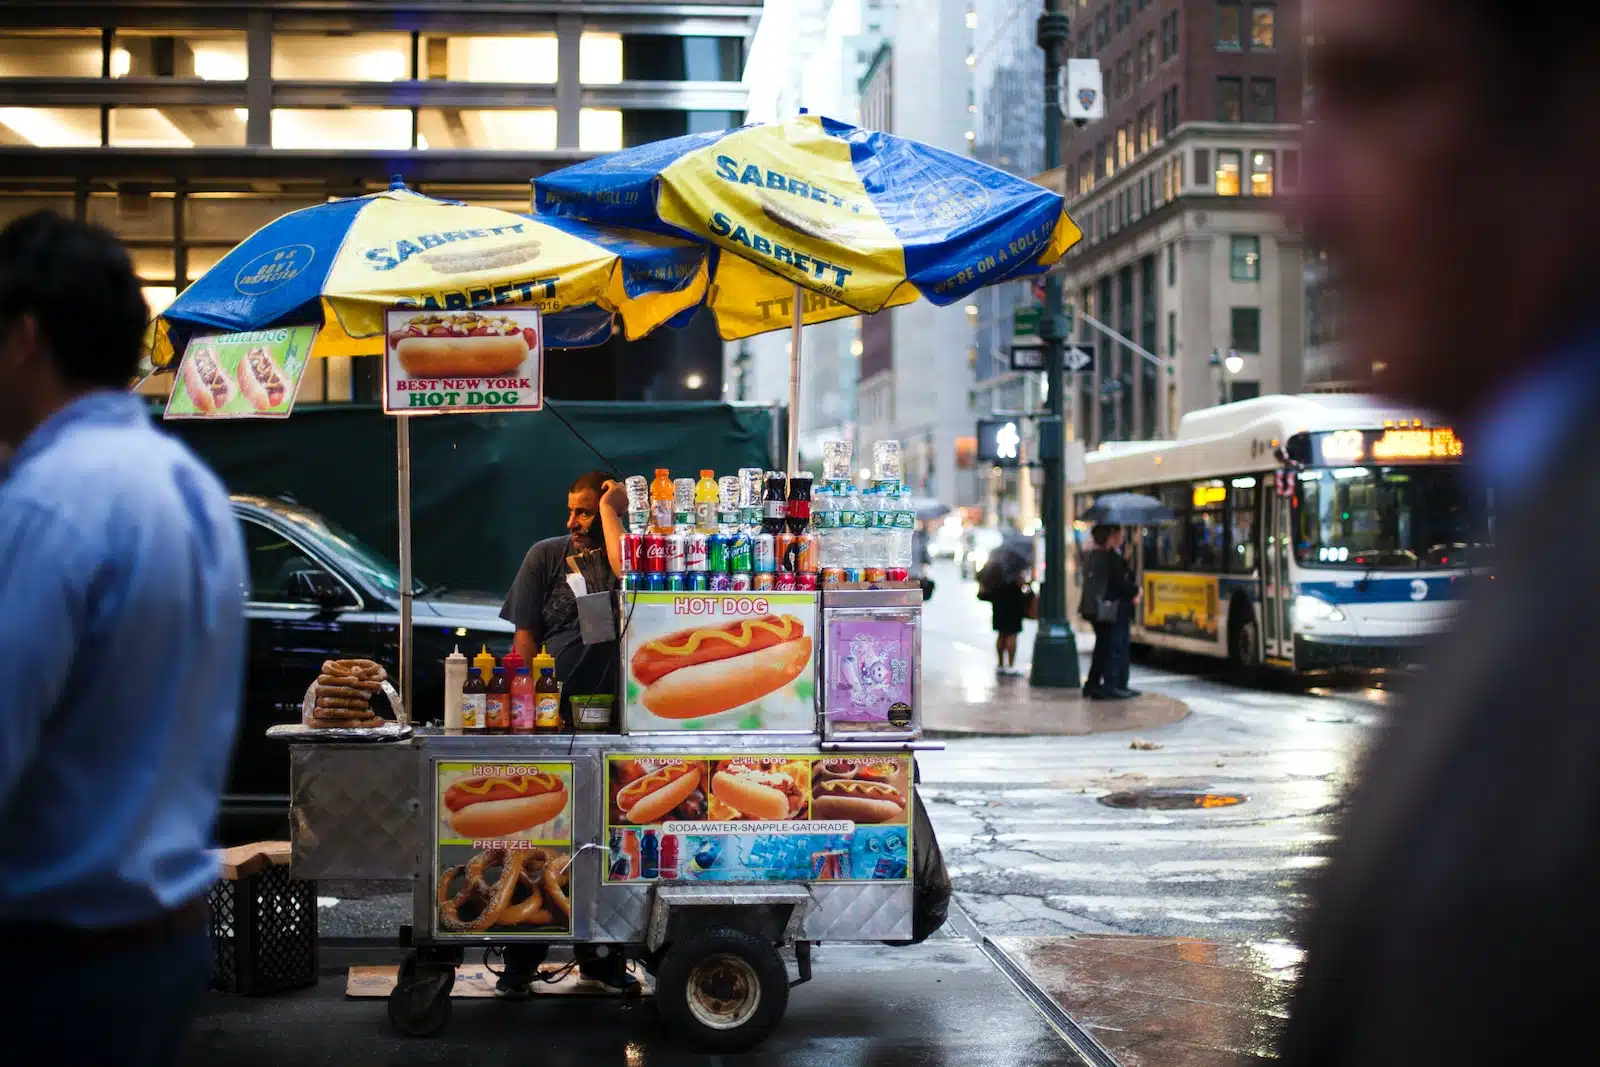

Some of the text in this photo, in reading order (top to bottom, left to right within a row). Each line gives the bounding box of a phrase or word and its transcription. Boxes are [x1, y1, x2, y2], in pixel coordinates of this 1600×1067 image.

[365, 223, 524, 271] SABRETT
[708, 211, 852, 288] SABRETT
[934, 267, 975, 293] WE'RE
[977, 255, 996, 273] ON
[999, 249, 1008, 262] A
[1009, 229, 1038, 256] ROLL
[820, 283, 843, 298] 2016
[533, 301, 560, 311] 2016
[396, 378, 530, 391] BEST NEW YORK
[409, 391, 520, 406] HOT DOG
[674, 597, 768, 615] HOT DOG
[634, 757, 683, 765] HOT DOG
[732, 757, 787, 765] CHILI DOG
[823, 756, 897, 765] HOT SAUSAGE
[472, 765, 538, 776] HOT DOG
[668, 822, 849, 833] SODA-WATER-SNAPPLE-GATORADE
[473, 840, 537, 850] PRETZEL
